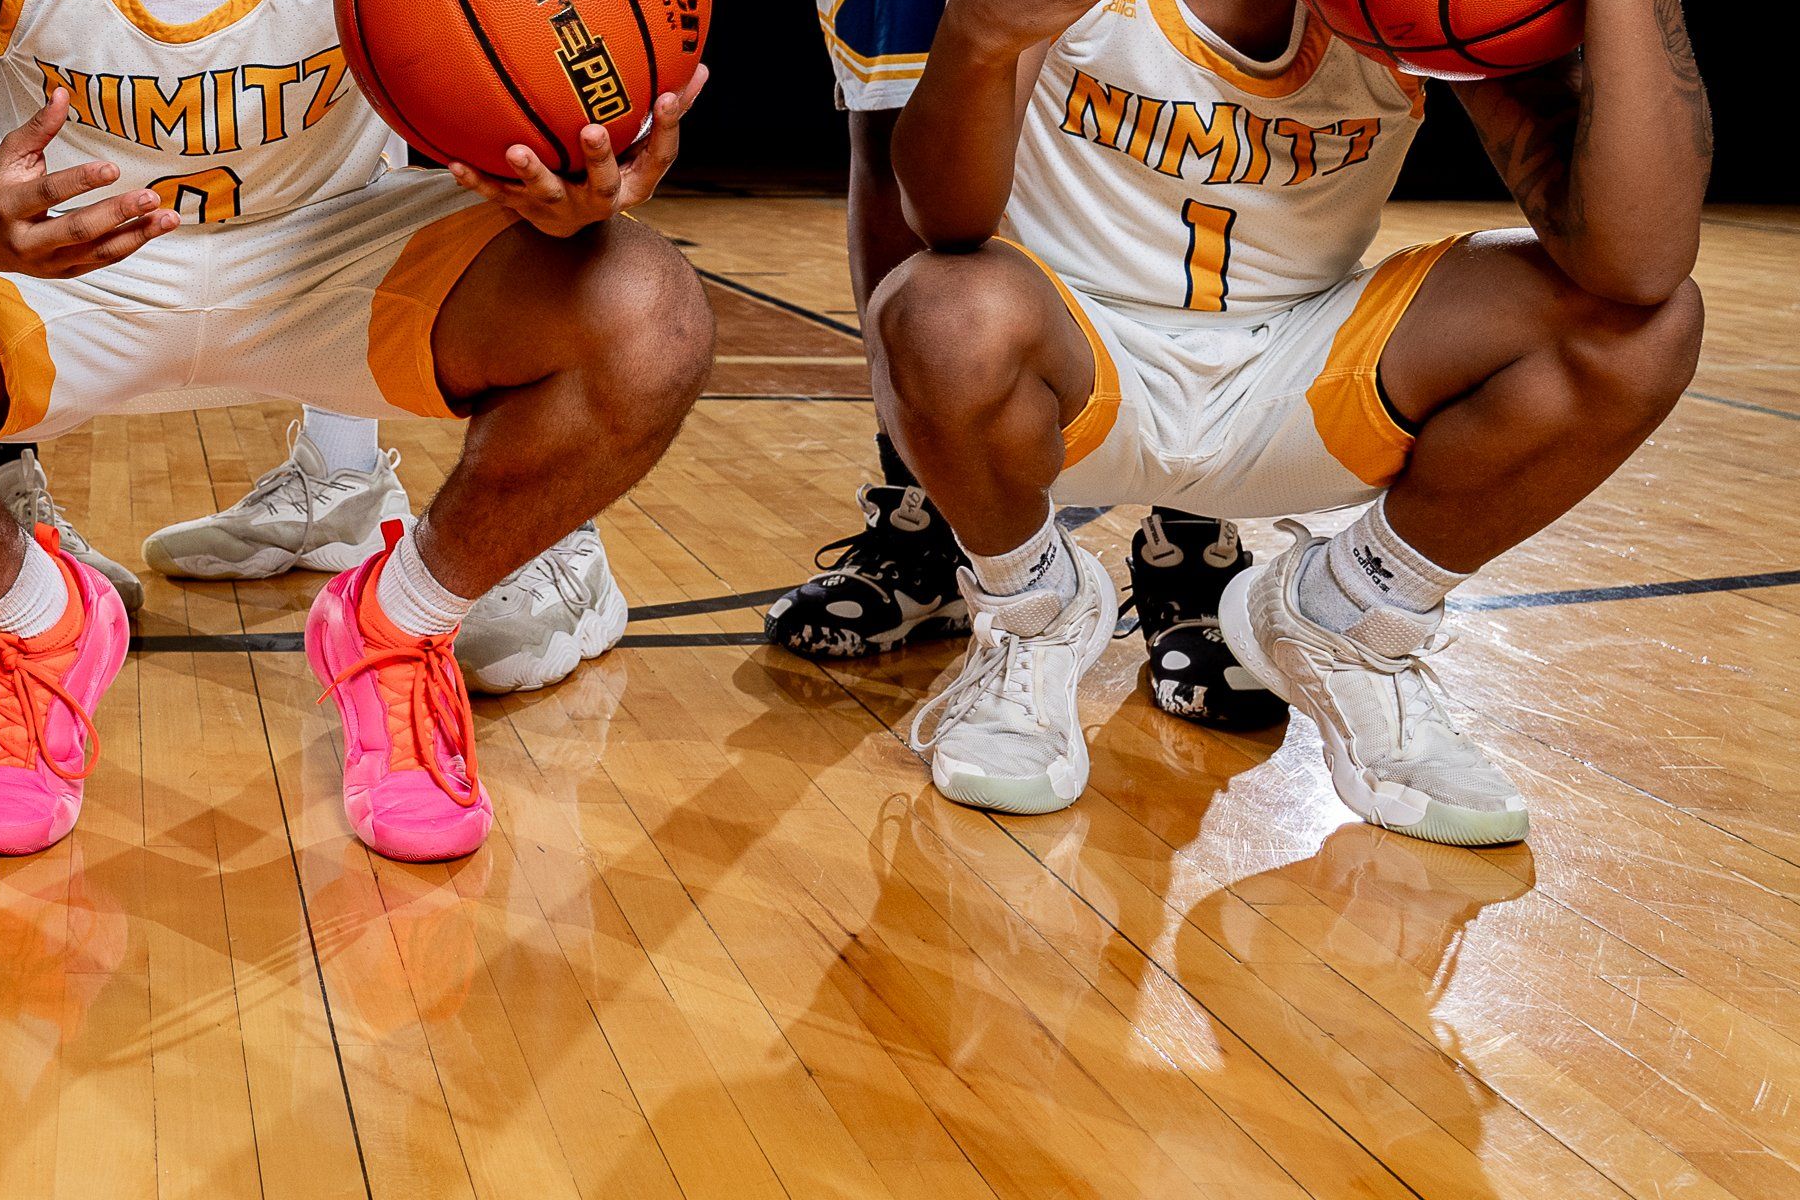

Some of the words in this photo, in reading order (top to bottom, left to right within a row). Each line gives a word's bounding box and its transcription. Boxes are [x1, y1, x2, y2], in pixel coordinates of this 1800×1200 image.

[34, 44, 350, 156] NIMITZ
[572, 53, 626, 123] PRO
[1181, 198, 1237, 312] 1
[1353, 547, 1390, 593] adidas
